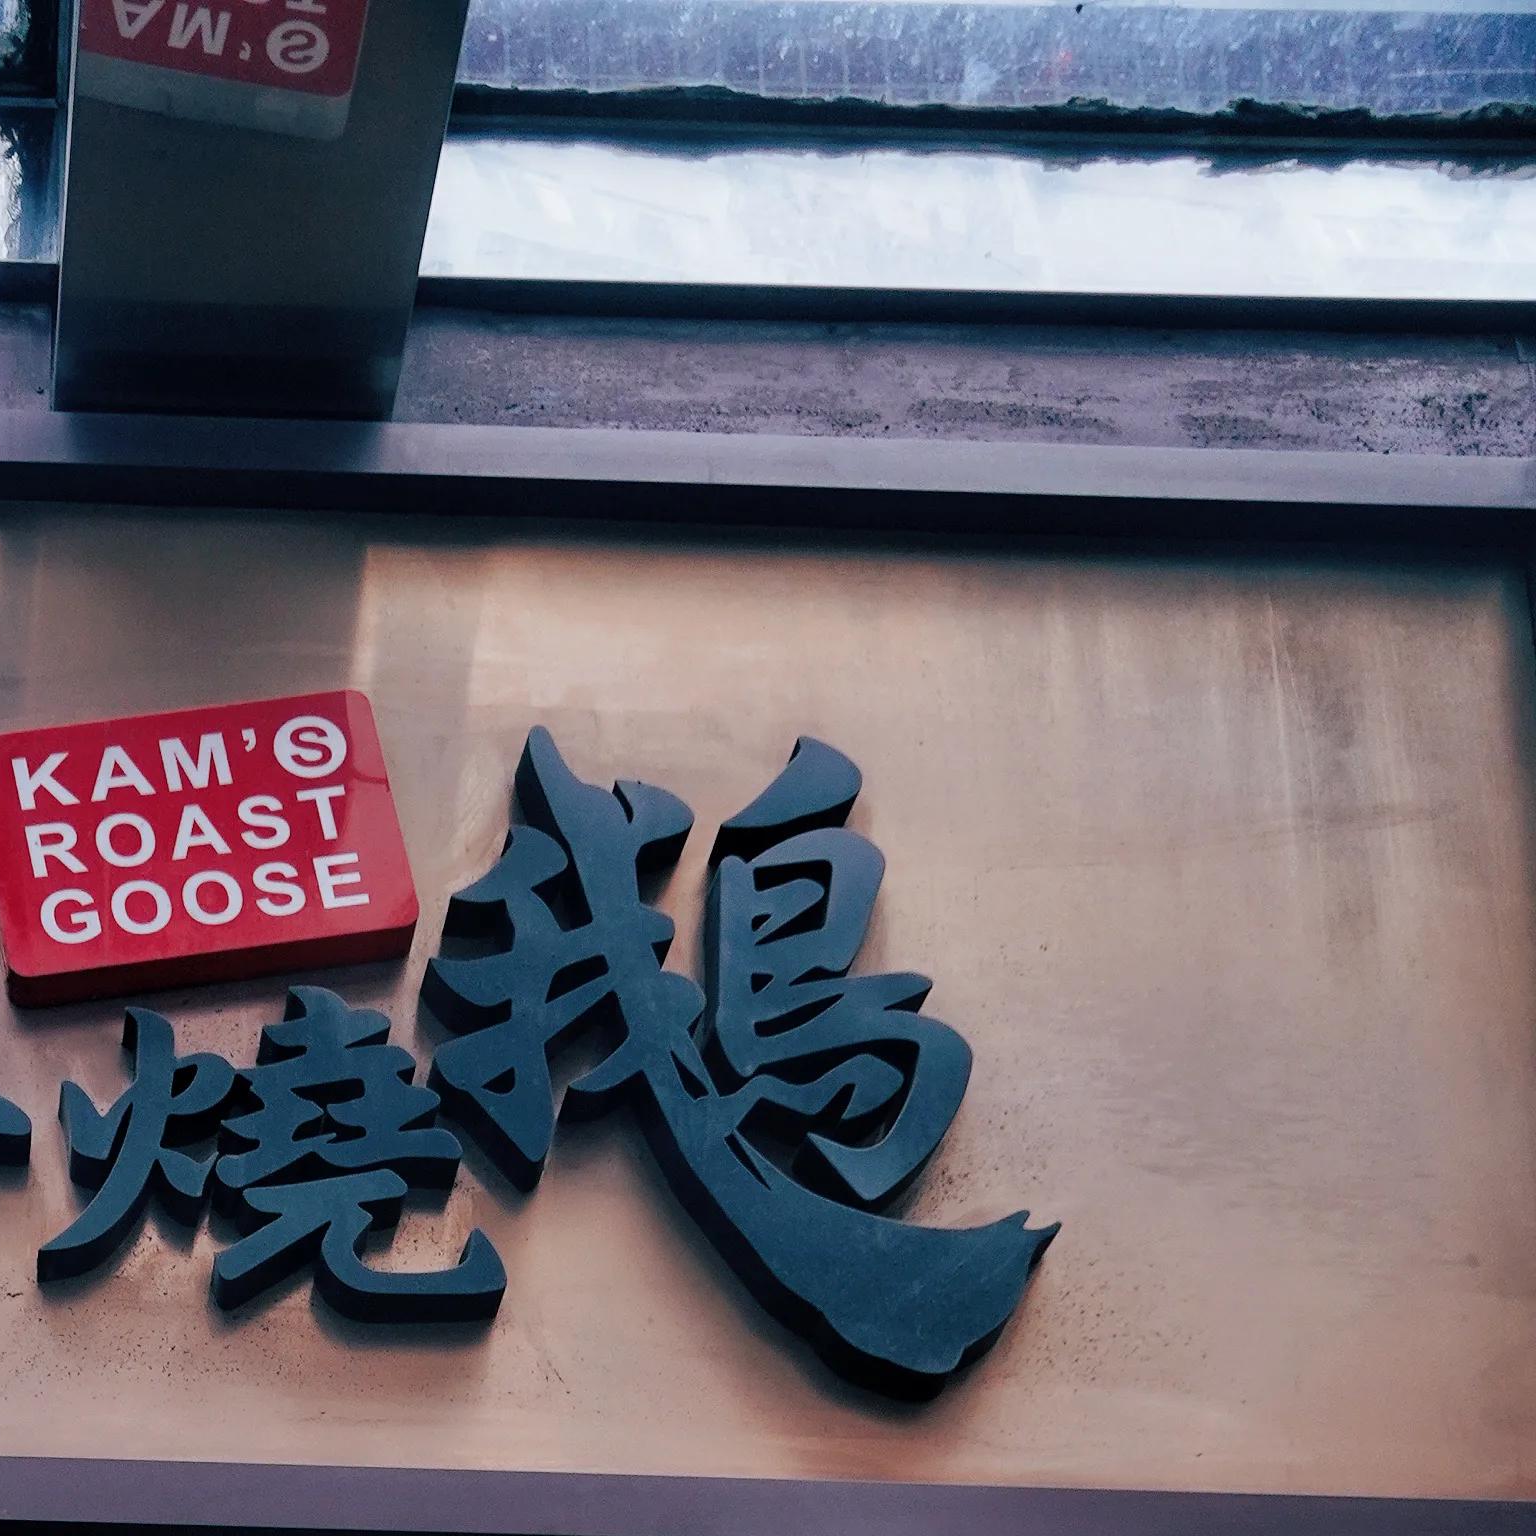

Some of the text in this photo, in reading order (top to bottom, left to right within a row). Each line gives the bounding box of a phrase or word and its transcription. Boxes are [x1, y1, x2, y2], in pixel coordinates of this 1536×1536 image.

[11, 714, 348, 811] KAM'S
[24, 784, 347, 878] ROAST
[39, 851, 370, 945] GOOSE
